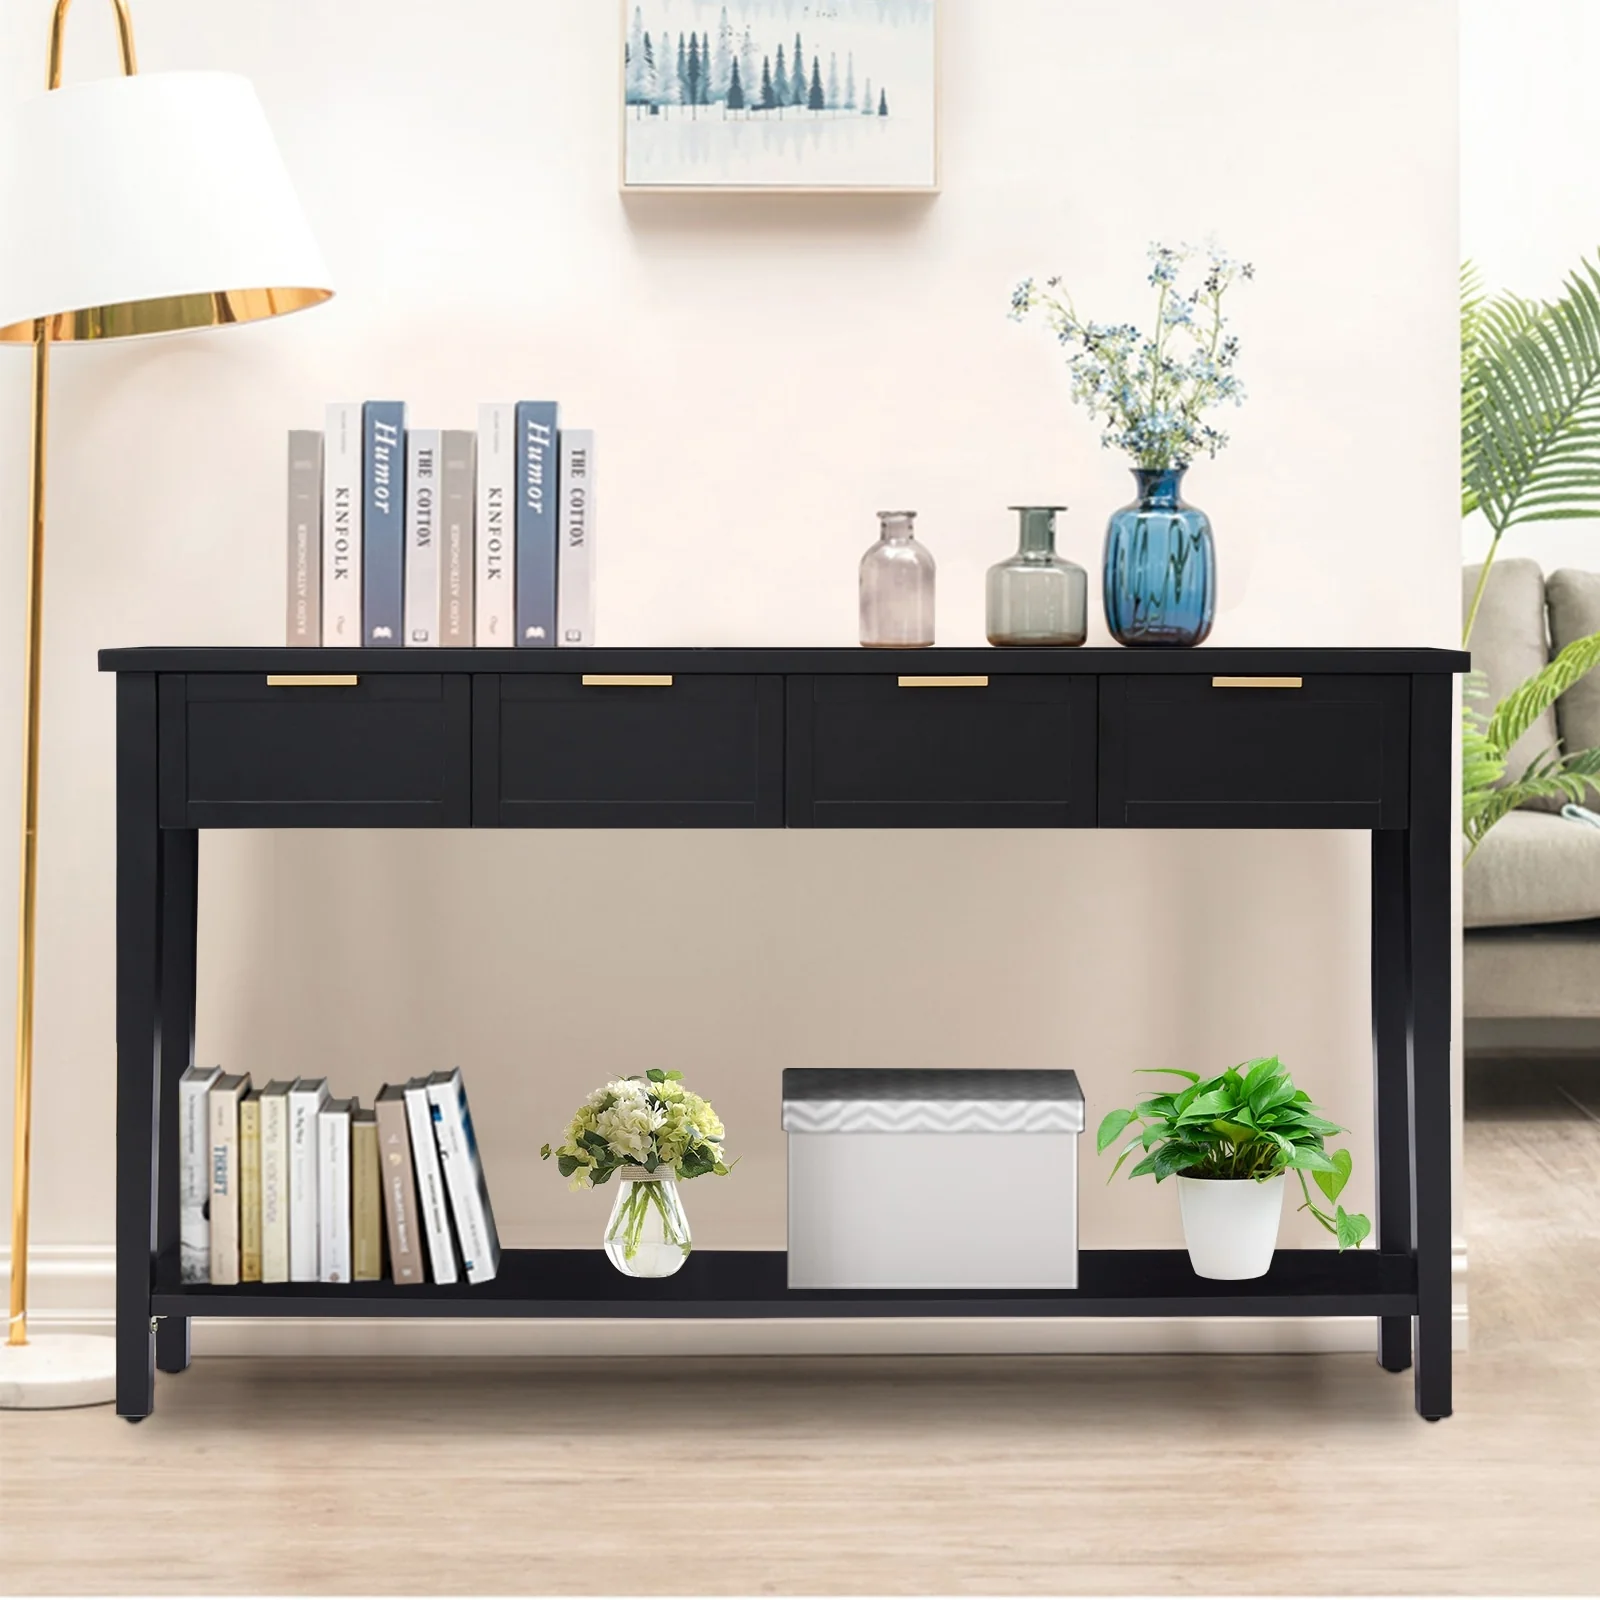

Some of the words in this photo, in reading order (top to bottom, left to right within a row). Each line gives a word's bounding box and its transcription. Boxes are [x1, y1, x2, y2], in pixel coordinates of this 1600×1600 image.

[374, 420, 397, 513] Humor
[418, 449, 433, 479] THE
[527, 420, 550, 513] Humor
[571, 449, 586, 479] THE
[334, 487, 349, 580] KINFOLK
[416, 488, 433, 547] COTTON
[487, 487, 502, 580] KINFOLK
[569, 488, 586, 547] COTTON
